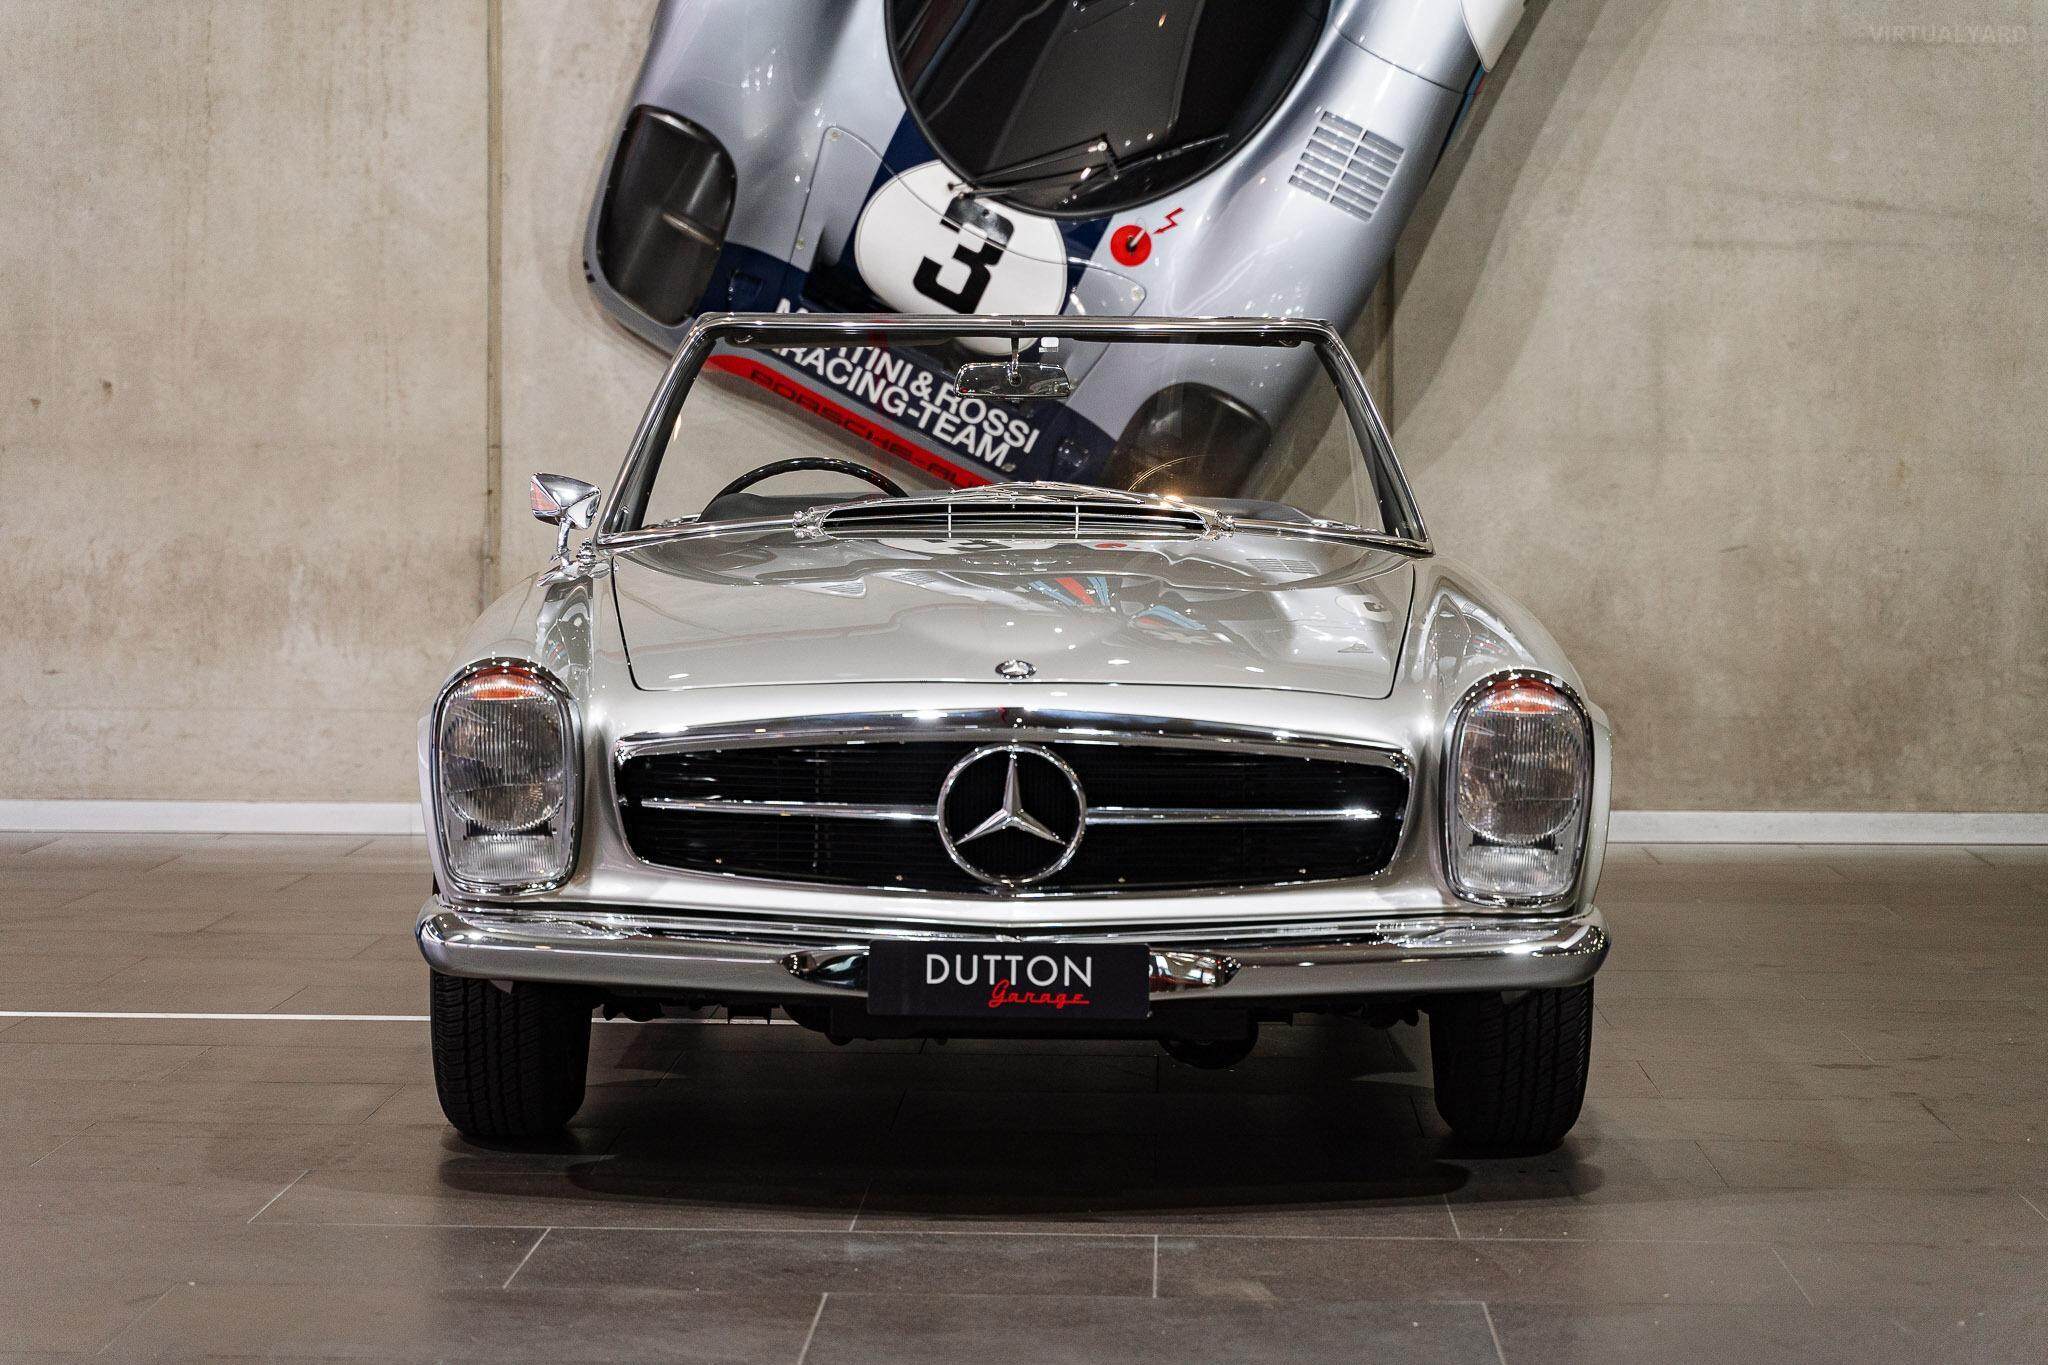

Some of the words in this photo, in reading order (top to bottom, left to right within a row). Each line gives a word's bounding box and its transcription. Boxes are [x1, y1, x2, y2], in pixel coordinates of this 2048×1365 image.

[913, 193, 1014, 314] 3
[909, 370, 934, 401] &
[934, 381, 1041, 454] ROSSI
[926, 953, 1092, 987] DUTTON
[988, 978, 1090, 1009] Garage
